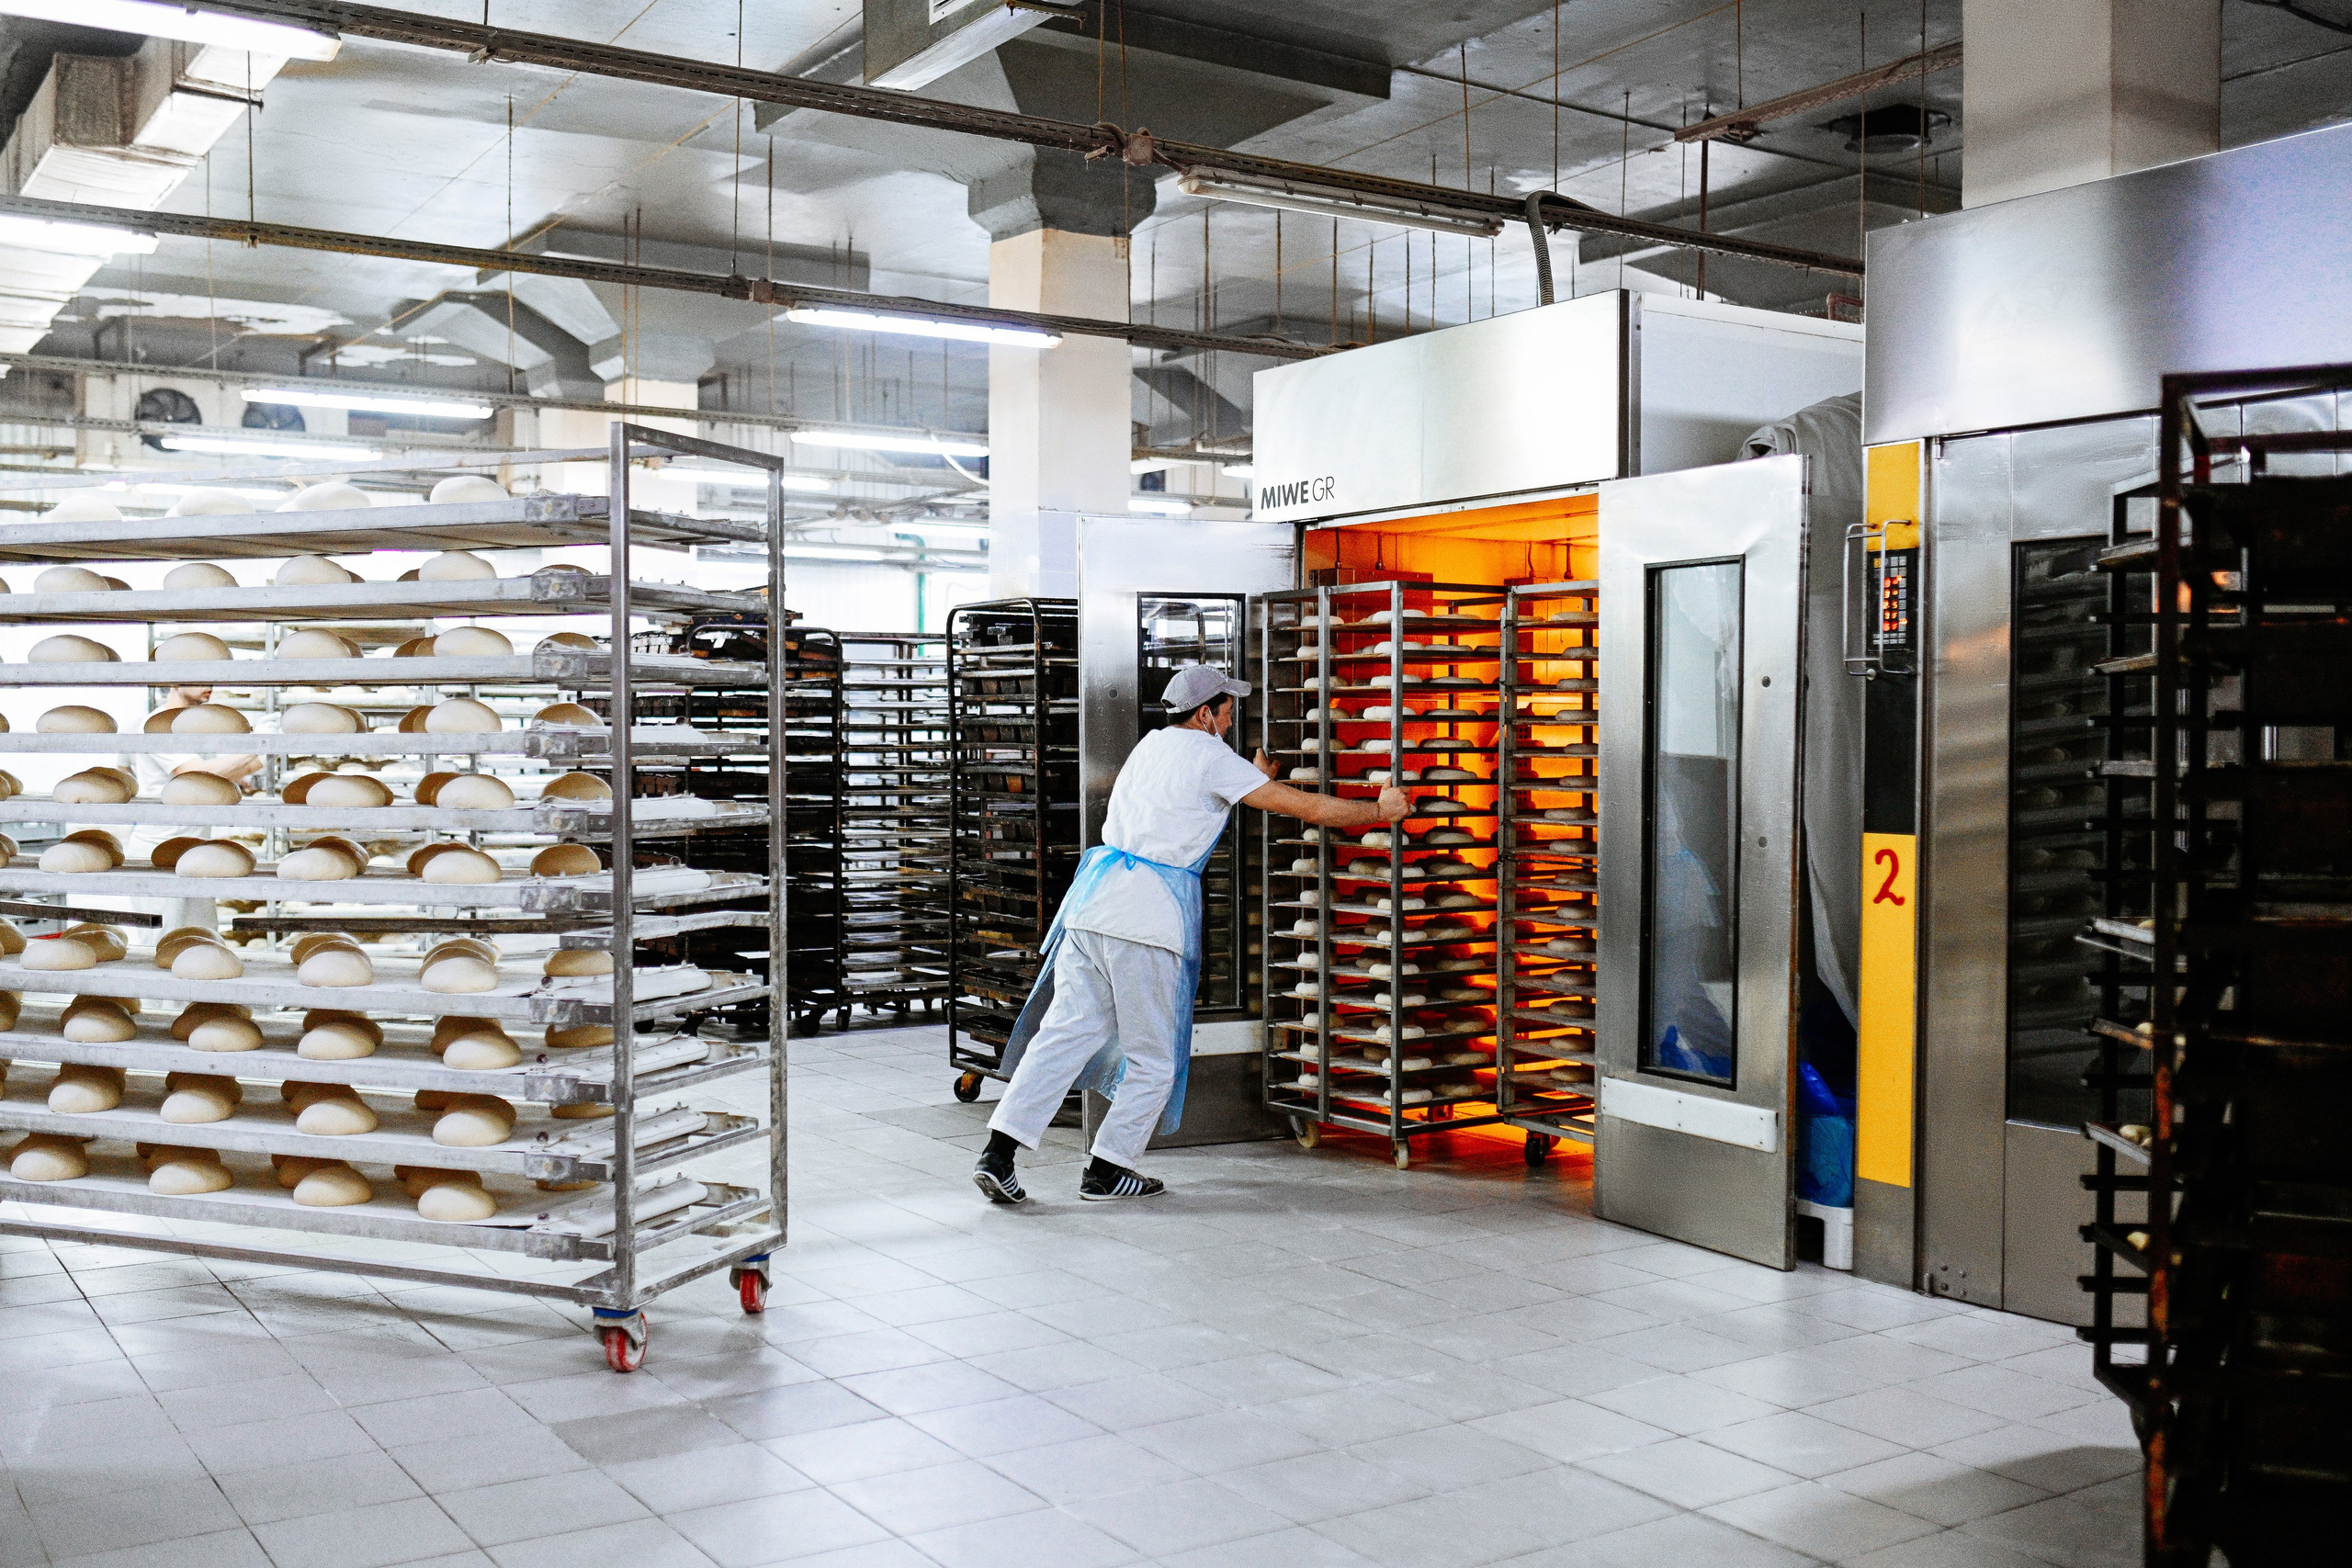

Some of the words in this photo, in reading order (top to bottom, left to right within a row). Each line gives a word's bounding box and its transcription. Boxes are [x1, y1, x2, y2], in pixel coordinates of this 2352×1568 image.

[1261, 480, 1309, 511] MIWE
[1312, 476, 1335, 502] GR
[1873, 849, 1905, 906] 2
